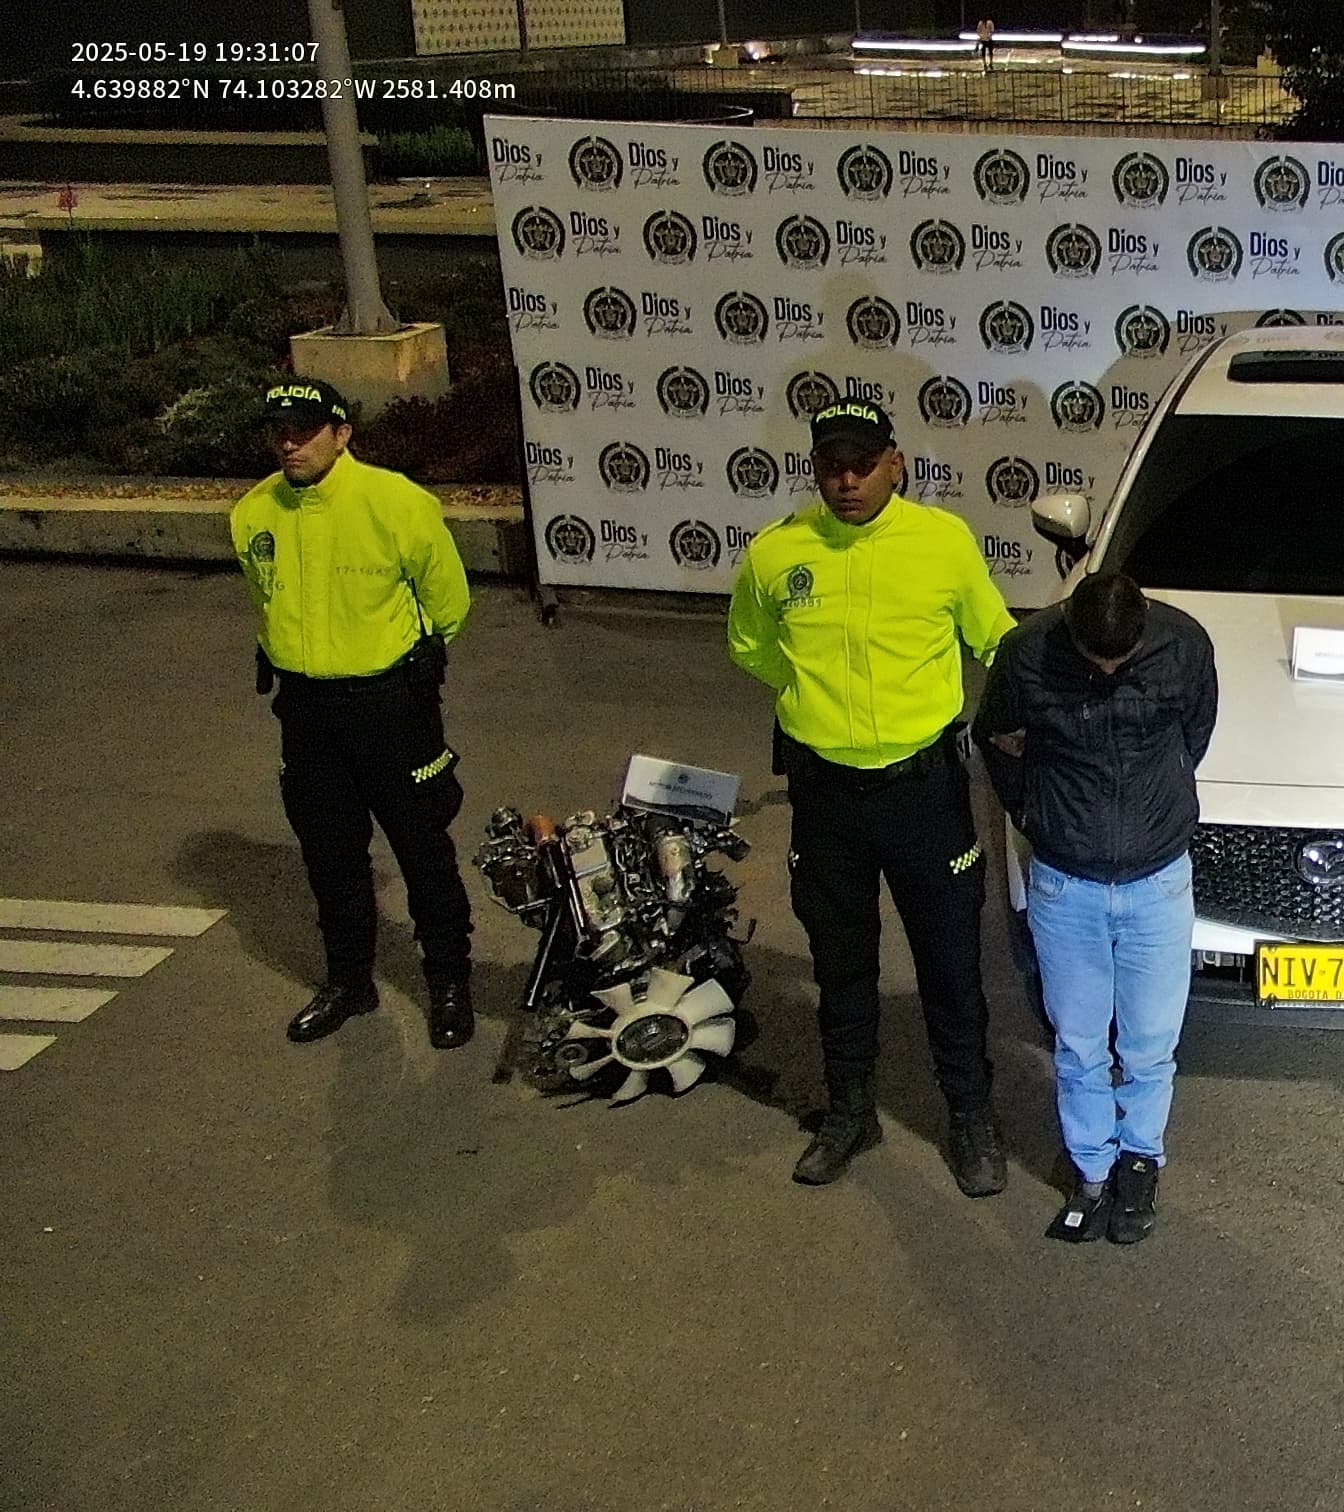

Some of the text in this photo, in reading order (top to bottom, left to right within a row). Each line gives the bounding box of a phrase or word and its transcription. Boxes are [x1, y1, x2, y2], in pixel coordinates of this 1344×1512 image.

[493, 138, 542, 167] Dios y
[628, 142, 678, 171] Dios y
[763, 147, 813, 176] Dios y
[899, 151, 950, 180] Dios y
[1037, 154, 1087, 183] Dios y
[1176, 158, 1226, 186] Dios y
[570, 211, 620, 240] Dios y
[702, 216, 752, 244] Dios y
[836, 221, 886, 249] Dios y
[972, 224, 1022, 253] Dios y
[1109, 228, 1159, 257] Dios y
[1250, 232, 1300, 260] Dios y
[509, 287, 557, 315] Dios y
[642, 292, 691, 320] Dios y
[774, 297, 824, 325] Dios y
[907, 302, 956, 330] Dios y
[1041, 306, 1090, 334] Dios y
[1177, 310, 1215, 334] Dios
[586, 367, 634, 394] Dios y
[715, 371, 764, 400] Dios y
[846, 377, 894, 404] Dios y
[979, 382, 1029, 410] Dios y
[1112, 386, 1149, 410] Dios
[526, 442, 573, 469] Dios y
[655, 448, 703, 474] Dios y
[914, 457, 963, 485] Dios y
[1046, 462, 1096, 486] Dios y
[601, 520, 648, 546] Dios y
[985, 535, 1032, 562] Dios y
